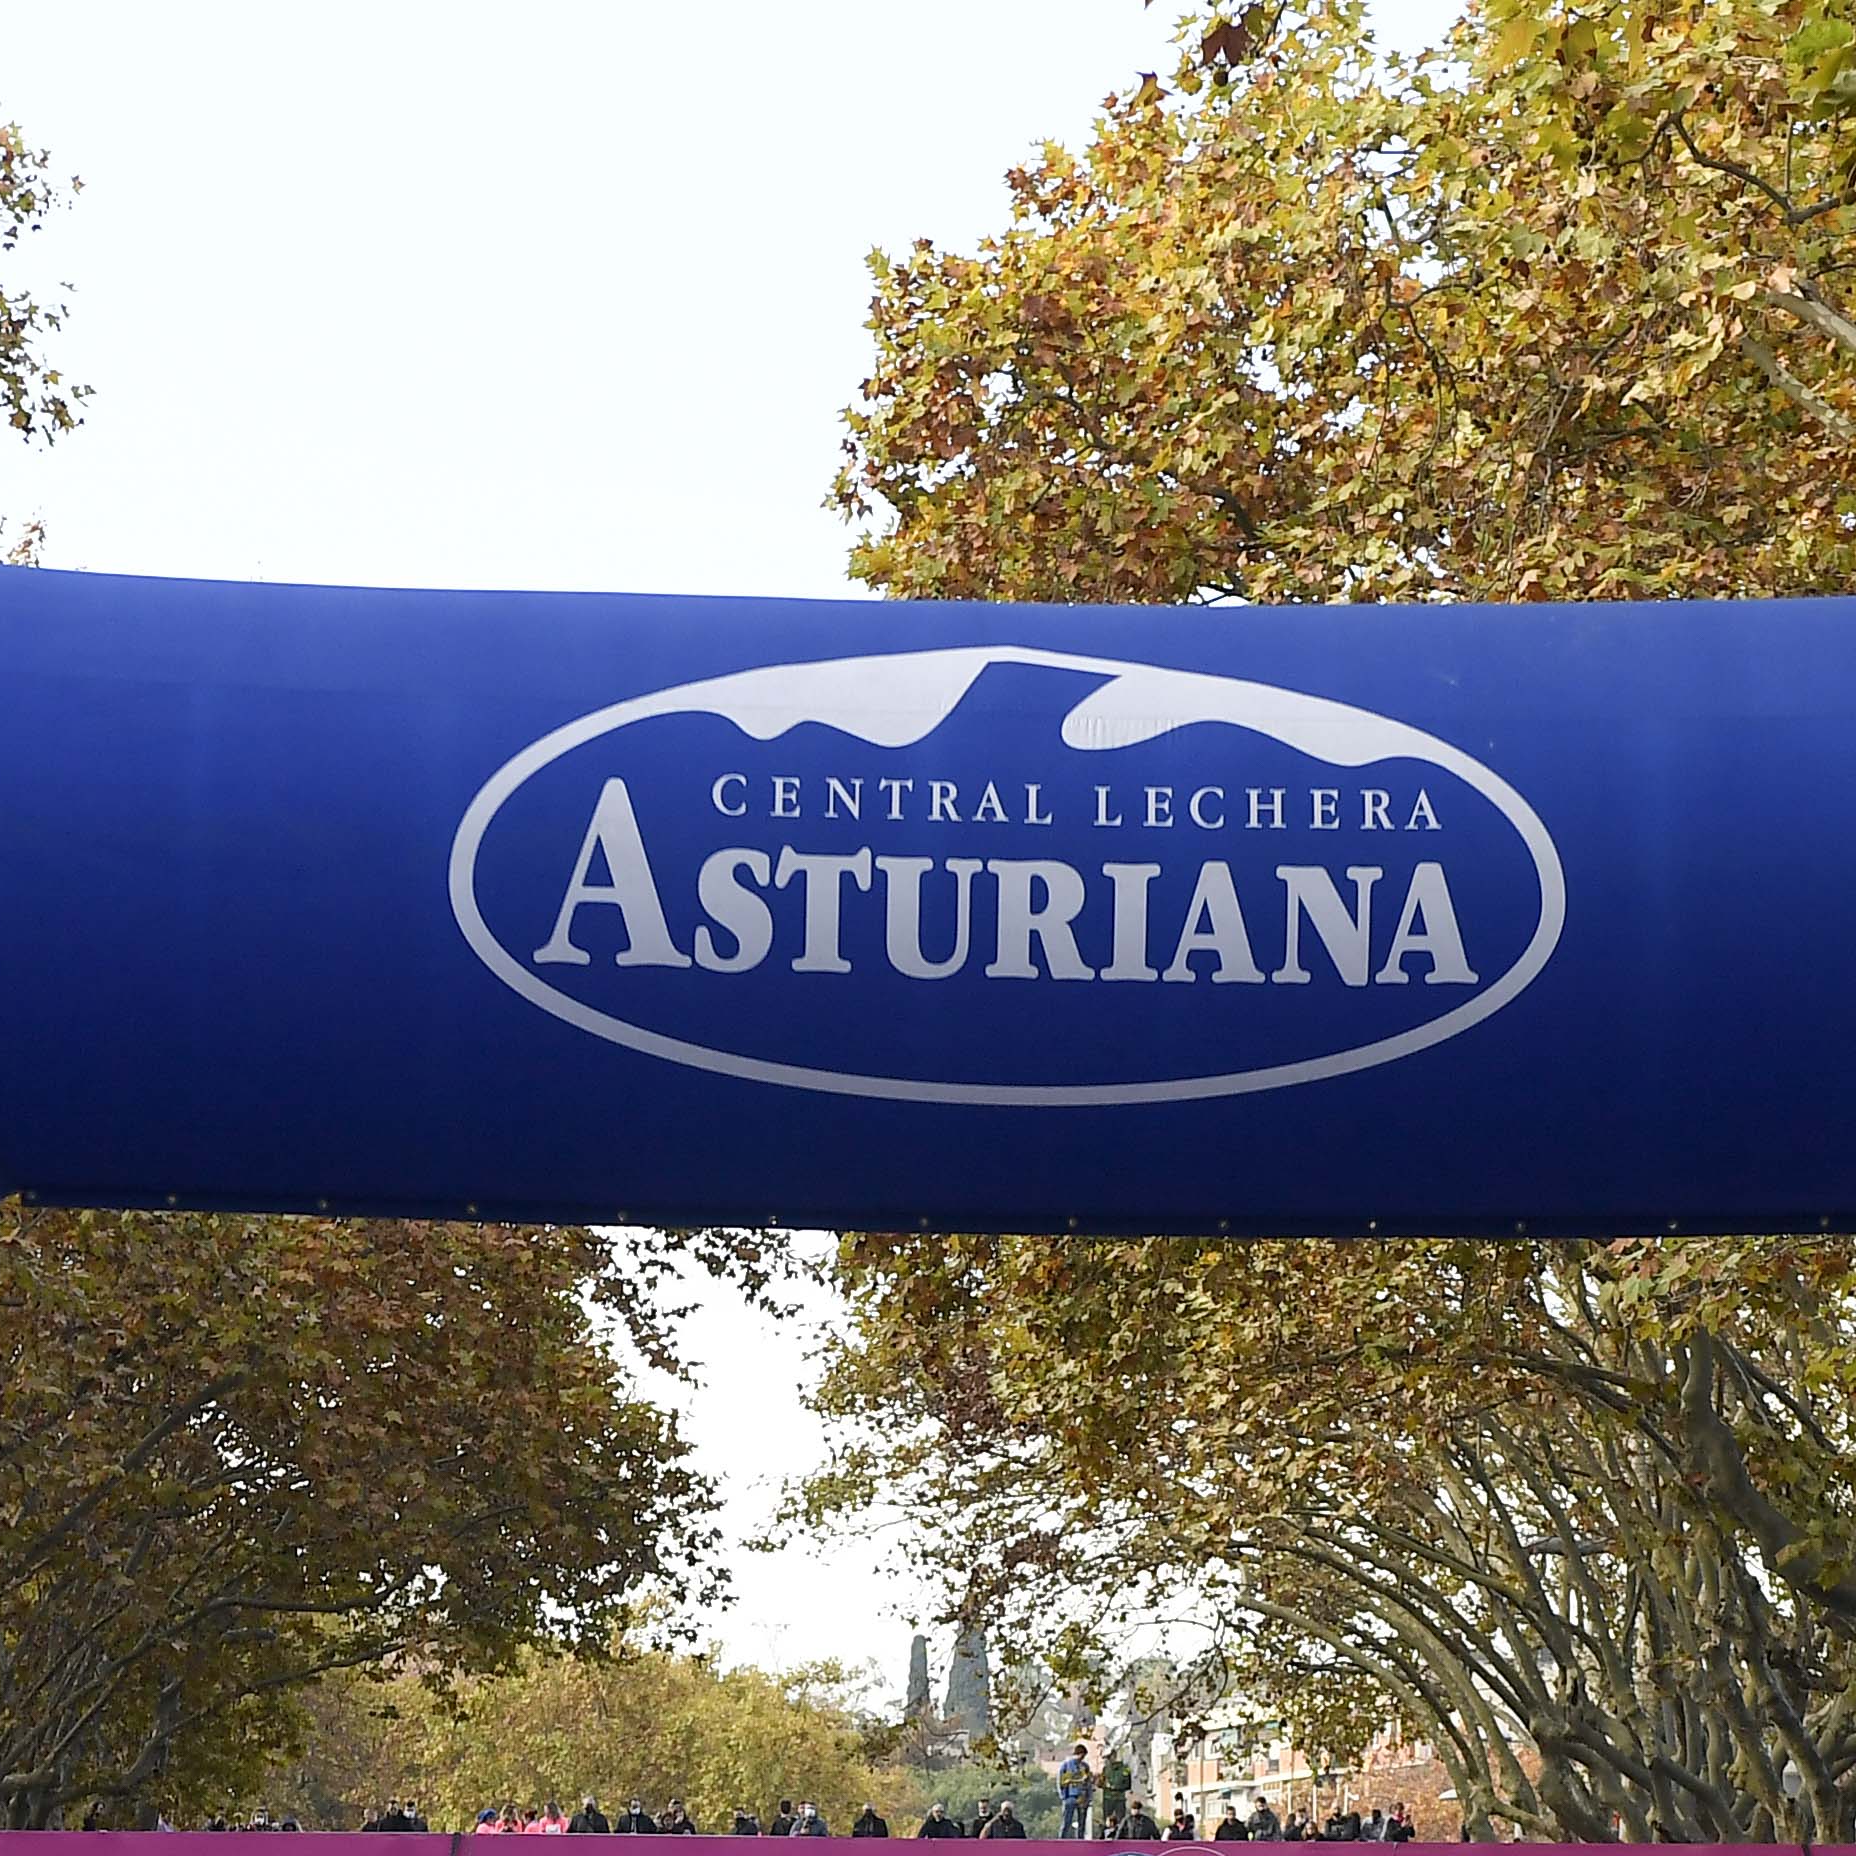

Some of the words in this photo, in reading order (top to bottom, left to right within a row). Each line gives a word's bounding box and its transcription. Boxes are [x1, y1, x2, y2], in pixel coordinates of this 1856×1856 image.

[711, 773, 1054, 826] CENTRAL
[1094, 785, 1442, 832] LECHERA
[533, 776, 1479, 987] ASTURIANA
